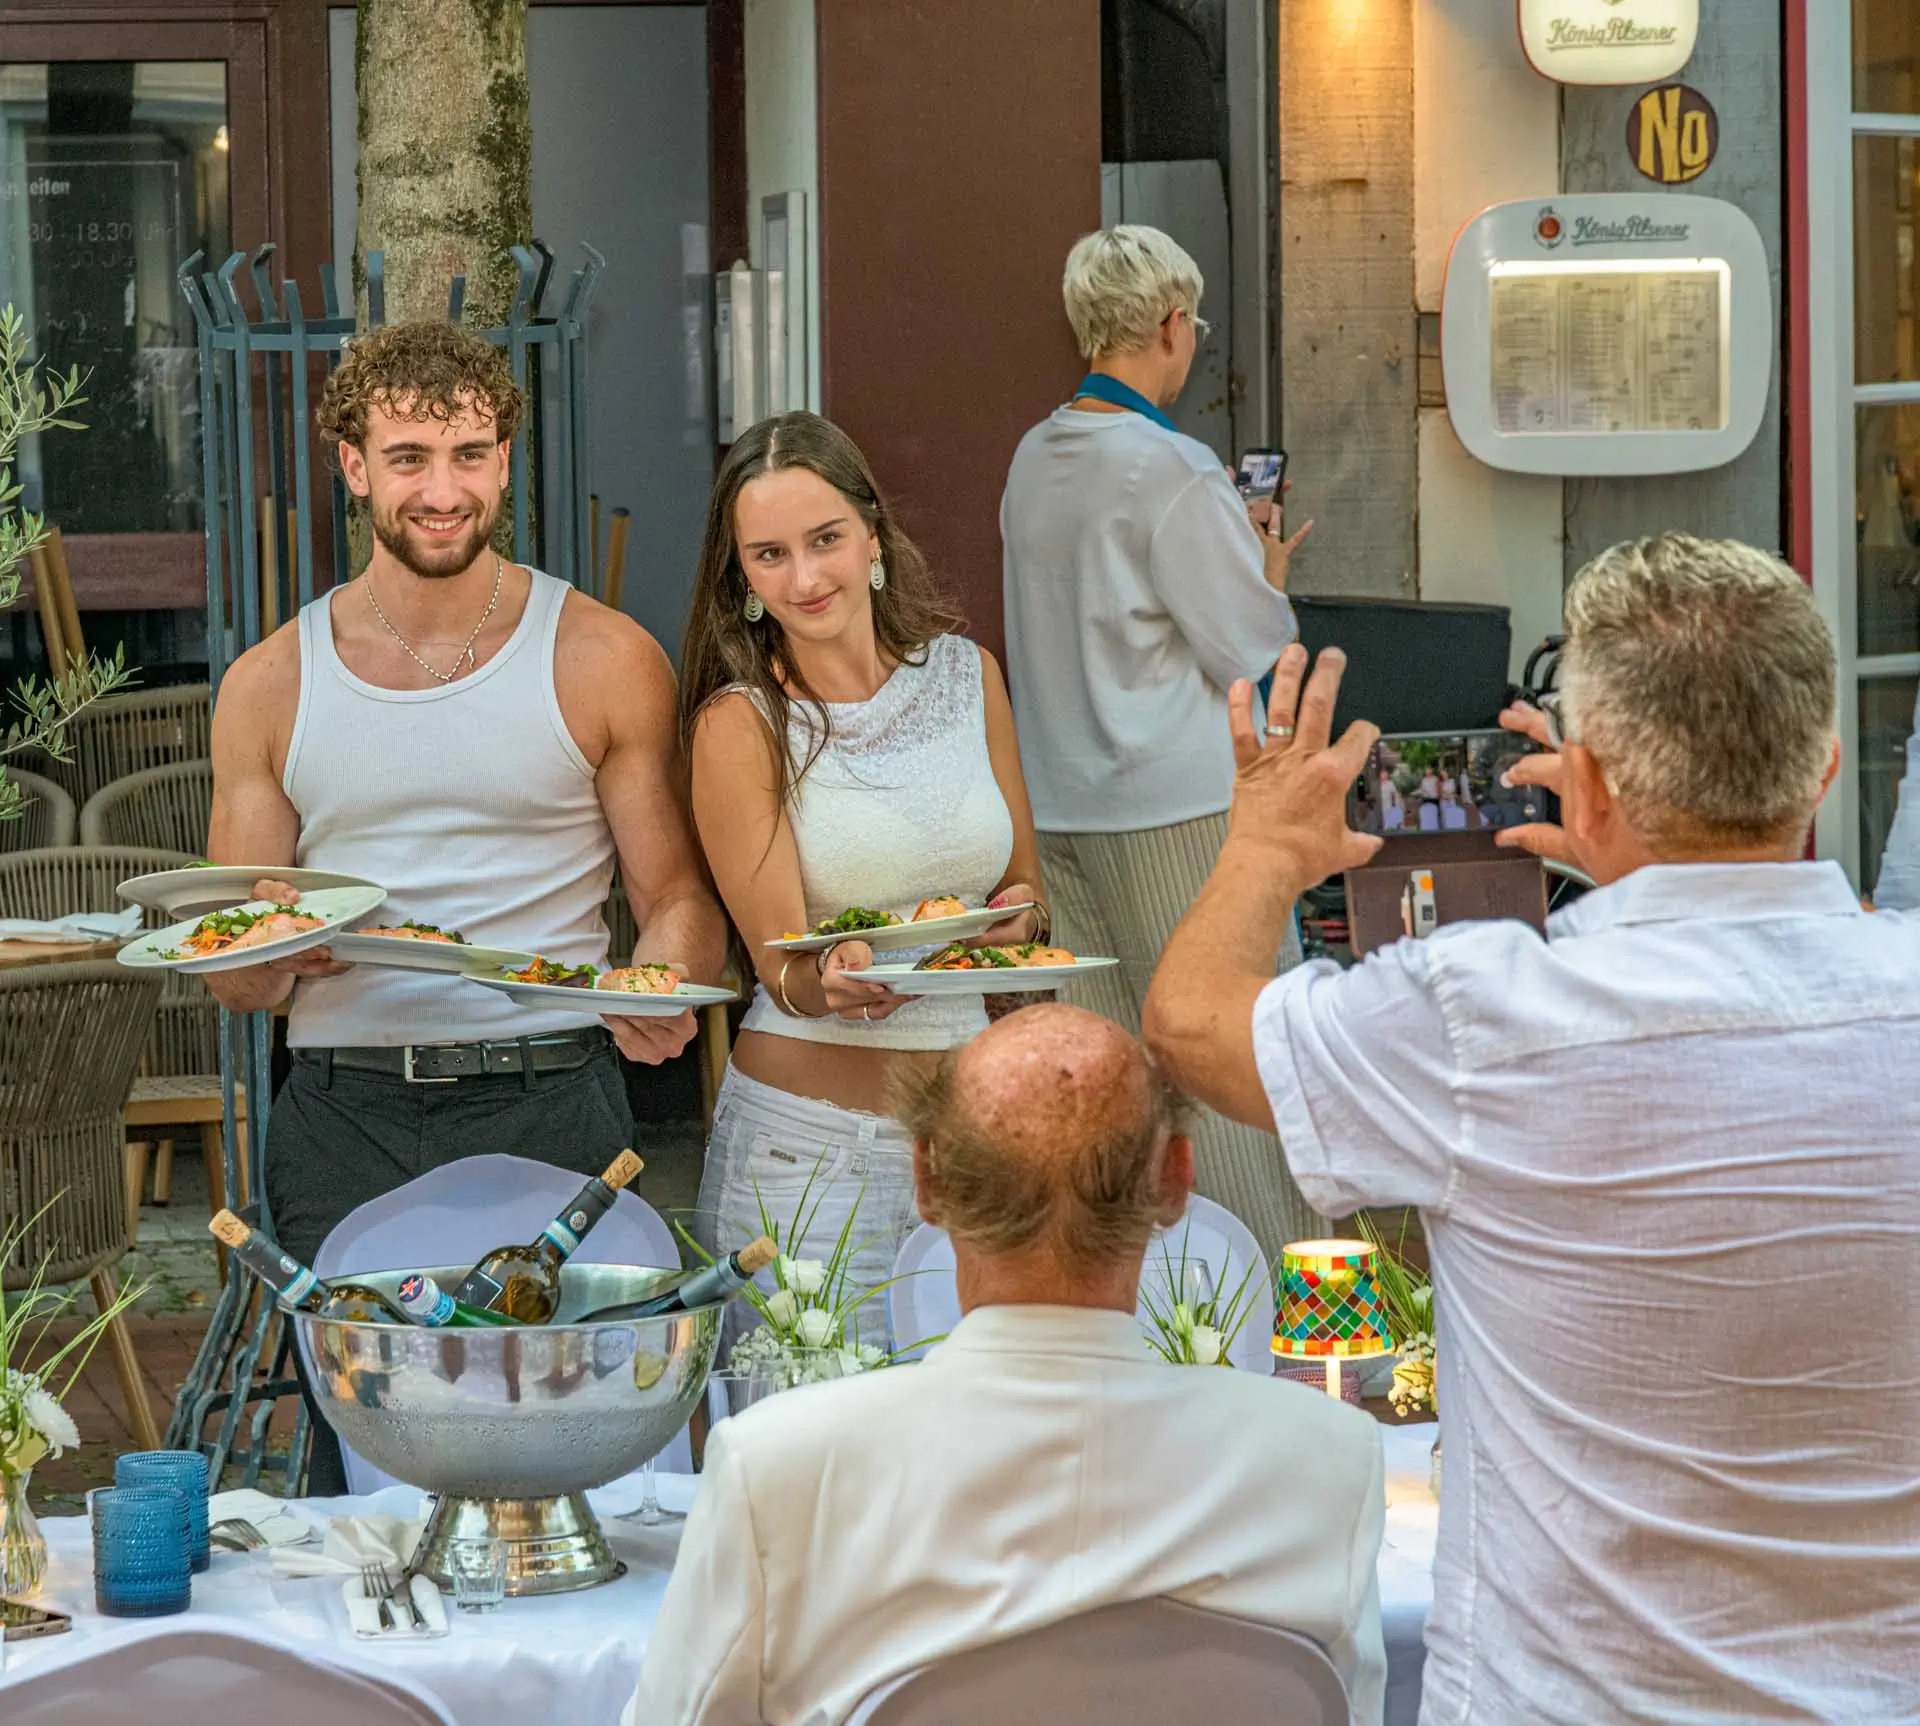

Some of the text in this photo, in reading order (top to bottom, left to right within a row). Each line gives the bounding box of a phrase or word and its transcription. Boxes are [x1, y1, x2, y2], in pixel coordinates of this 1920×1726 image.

[1547, 16, 1678, 46] König Pilsener
[1638, 86, 1709, 181] No
[76, 222, 133, 241] 18.30
[1571, 214, 1690, 241] König Pilsener
